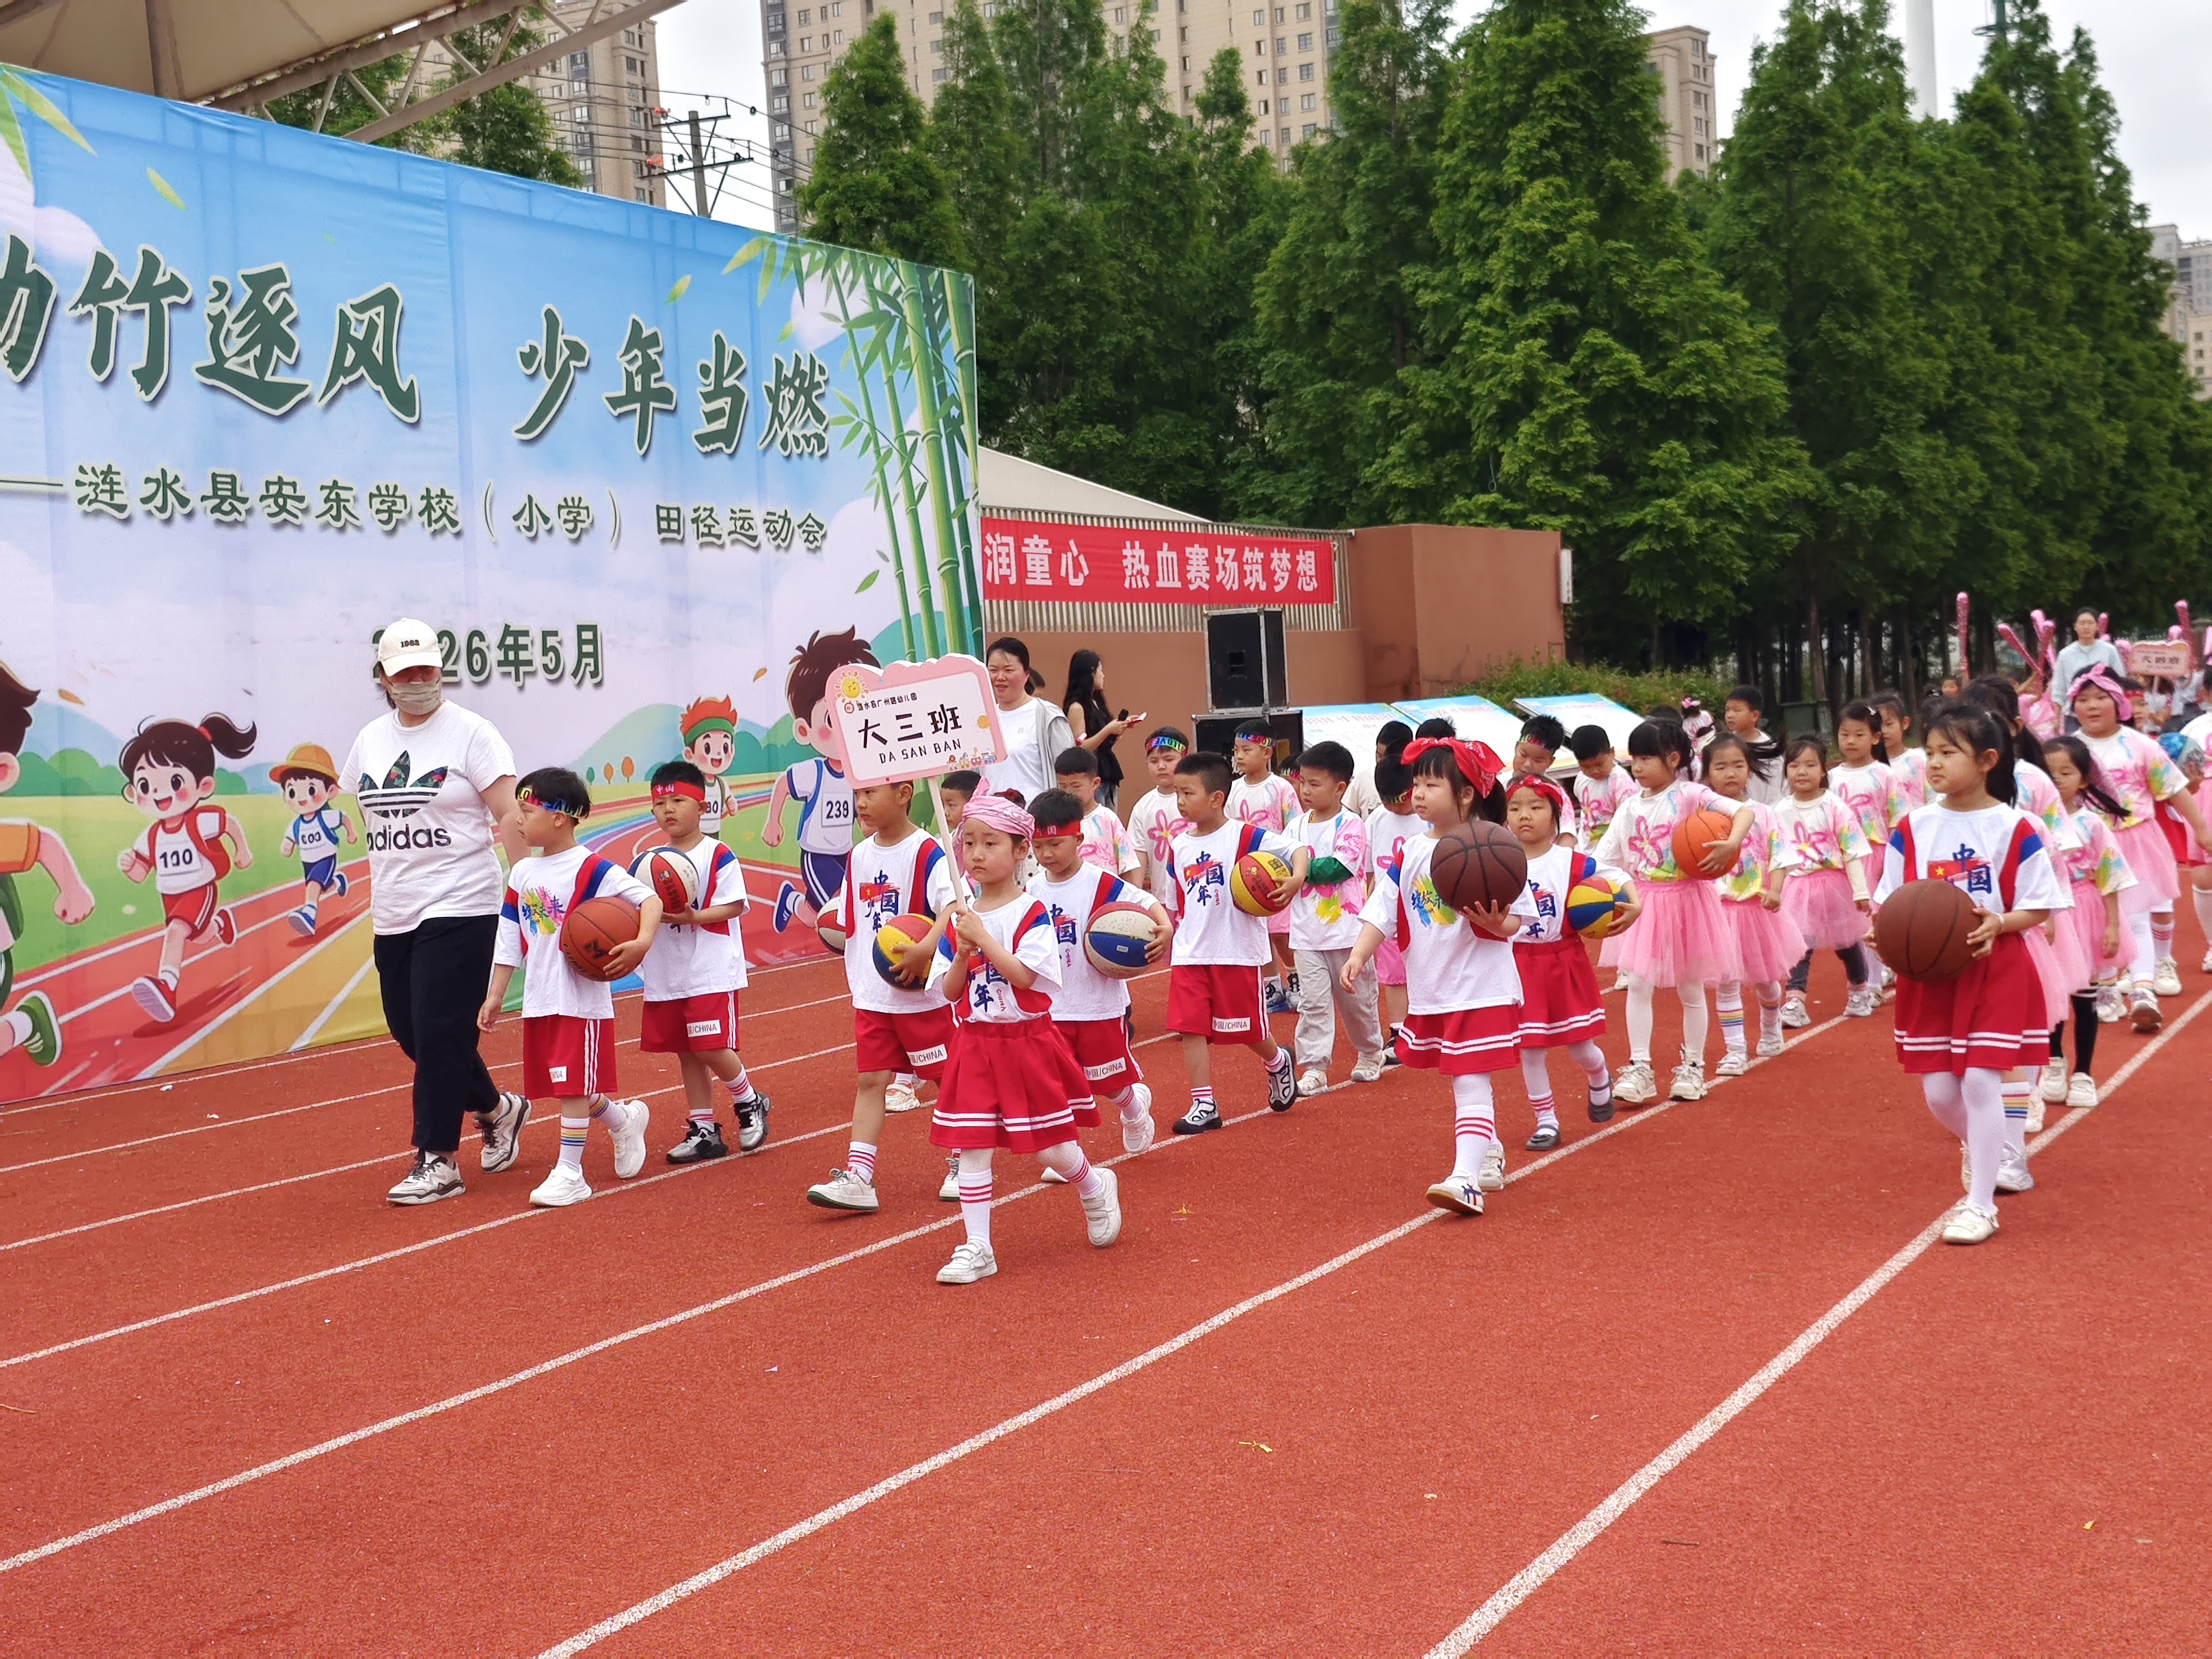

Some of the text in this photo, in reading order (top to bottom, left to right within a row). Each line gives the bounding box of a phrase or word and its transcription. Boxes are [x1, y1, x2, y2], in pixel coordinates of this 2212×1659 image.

[514, 307, 828, 455] 少年当燃
[984, 532, 1318, 592] 润童心 热血赛场筑梦想
[372, 623, 601, 682] 26年5月
[858, 704, 962, 748] 大三班
[879, 738, 962, 764] DA SAN BAN
[826, 800, 849, 819] 238
[160, 848, 193, 868] 100
[367, 824, 451, 852] adidas
[1953, 844, 1992, 894] 中国
